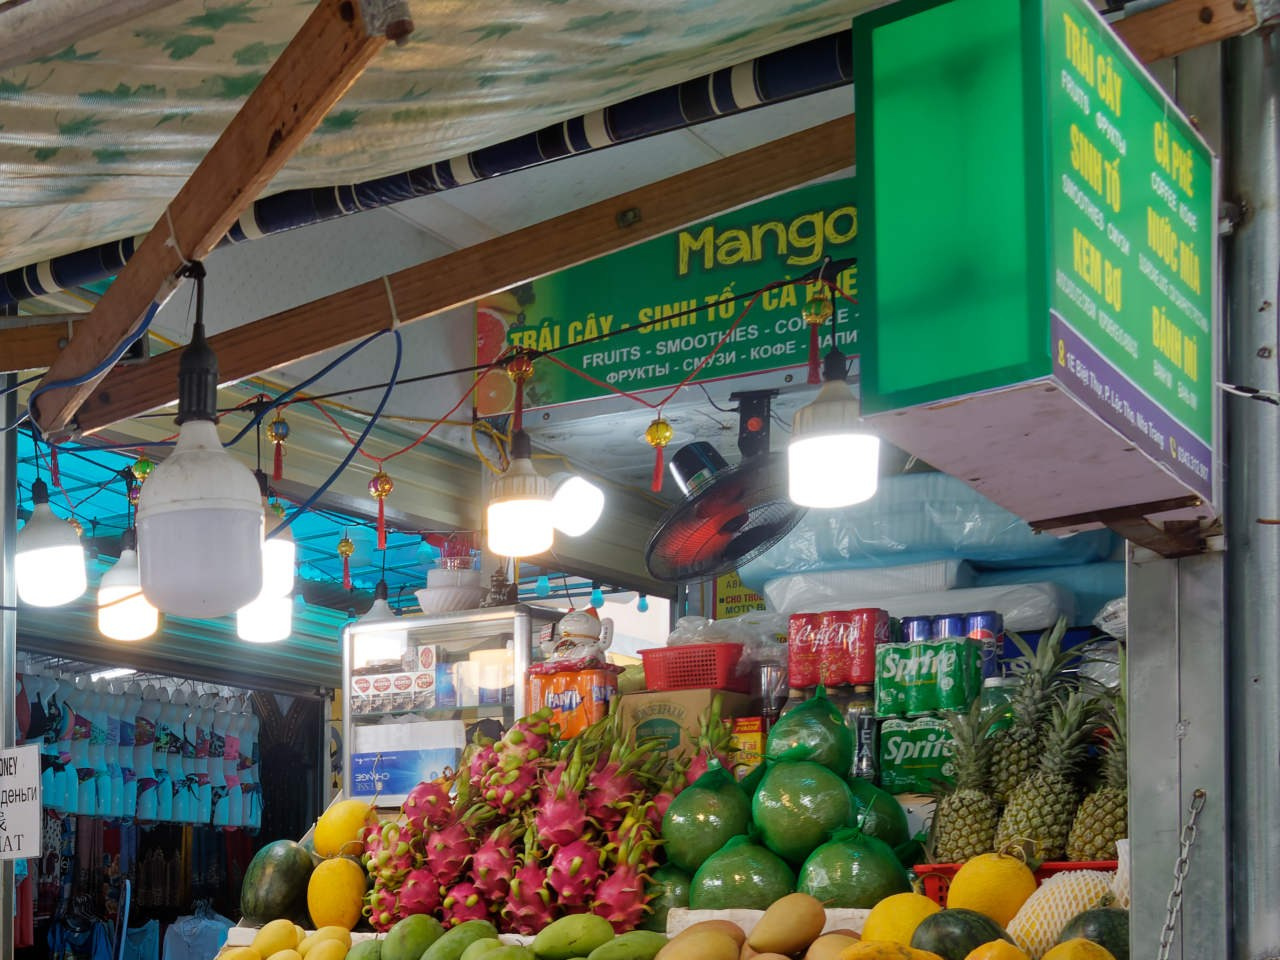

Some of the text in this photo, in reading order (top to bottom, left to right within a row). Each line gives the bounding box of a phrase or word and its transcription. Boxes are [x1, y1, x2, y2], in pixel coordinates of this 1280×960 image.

[677, 205, 858, 276] Mango
[1073, 227, 1102, 296] KEM
[638, 299, 697, 334] SINH
[704, 280, 736, 322] TỐ
[582, 345, 641, 369] FRUITS
[656, 325, 759, 355] SMOOTHIES
[605, 363, 669, 384] ФРУКТЫ
[683, 351, 736, 374] СМУЗИ
[750, 342, 796, 362] КОФЕ
[882, 648, 956, 682] Sprite
[0, 786, 37, 808] деньги
